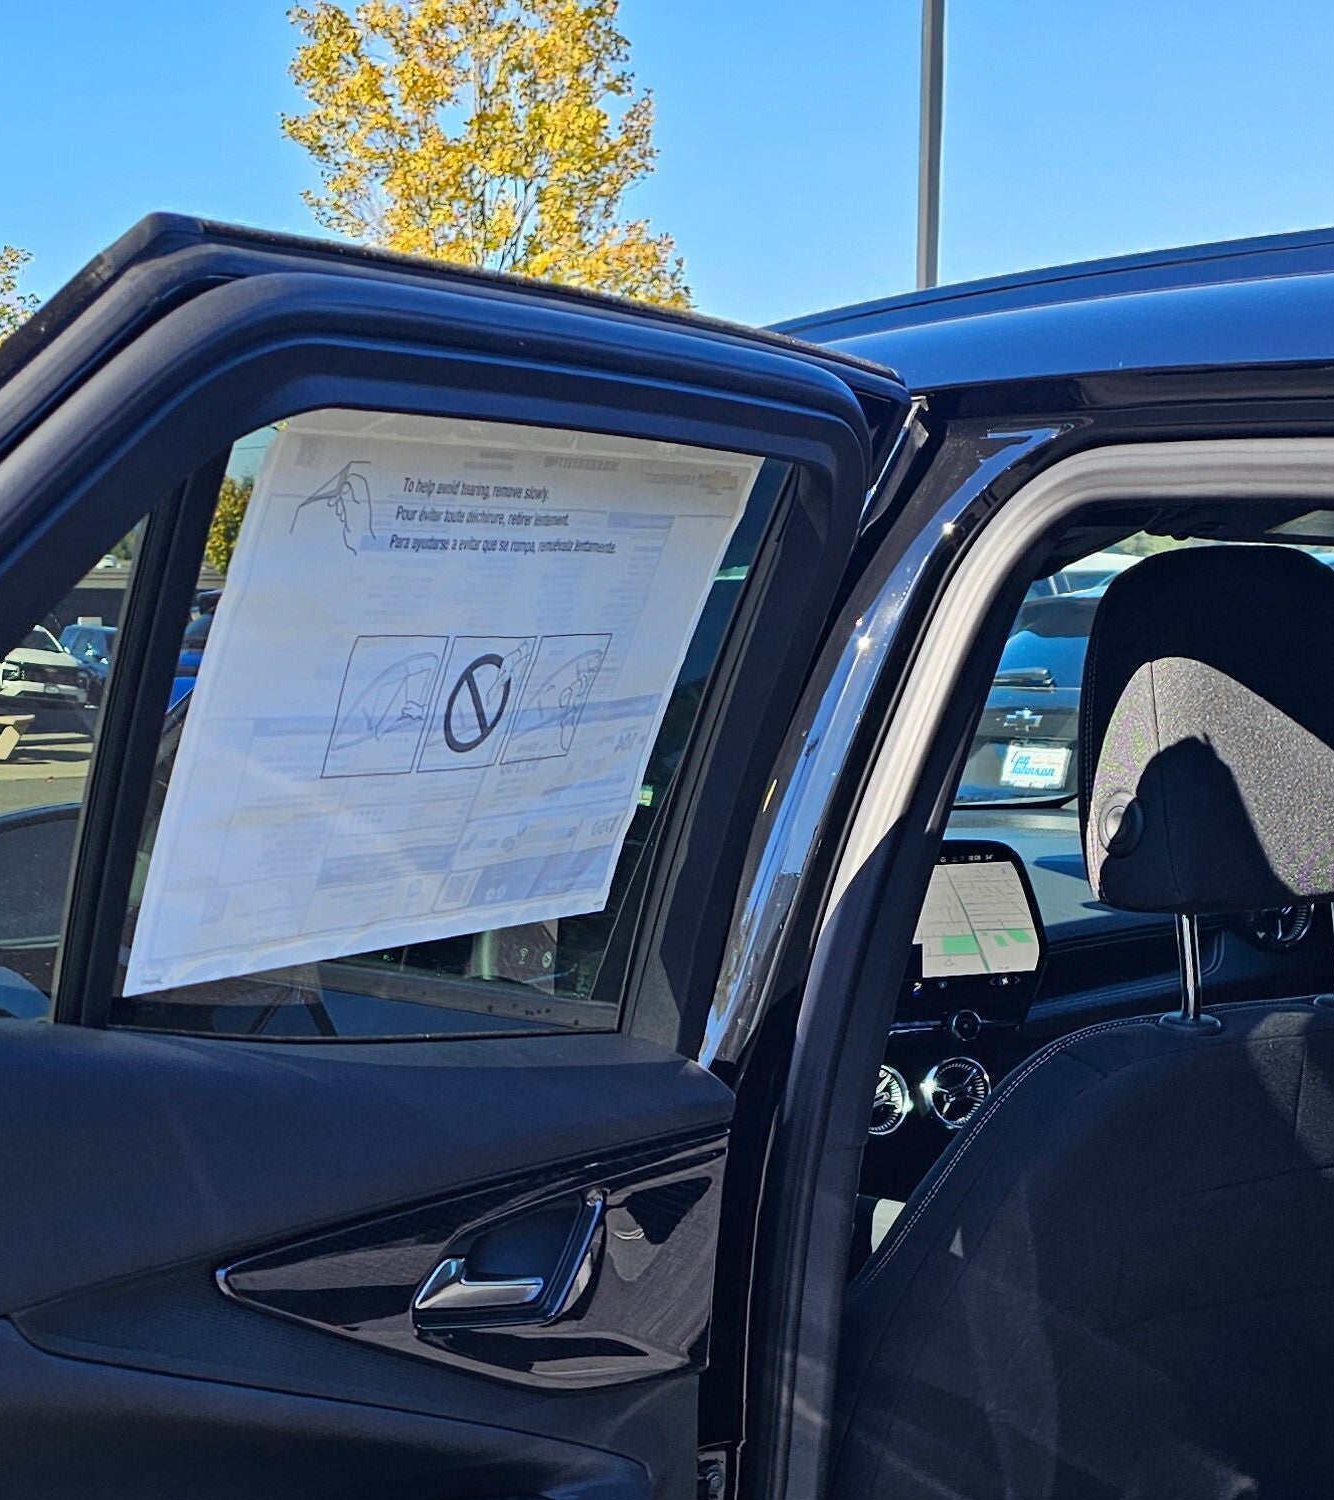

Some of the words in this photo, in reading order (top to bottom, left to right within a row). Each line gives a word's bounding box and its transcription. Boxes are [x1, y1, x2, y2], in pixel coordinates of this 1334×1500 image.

[404, 477, 415, 493] To
[415, 478, 436, 497] help
[436, 480, 461, 495] avoid
[461, 483, 490, 500] tearing,
[492, 486, 523, 498] remove
[524, 485, 550, 503] slowly.
[395, 505, 418, 521] Pour
[443, 508, 464, 523] toute
[507, 512, 534, 526] retirer
[389, 533, 411, 548] Para
[451, 539, 457, 550] a
[458, 536, 481, 550] evitar
[482, 540, 497, 554] que
[498, 540, 509, 552] se
